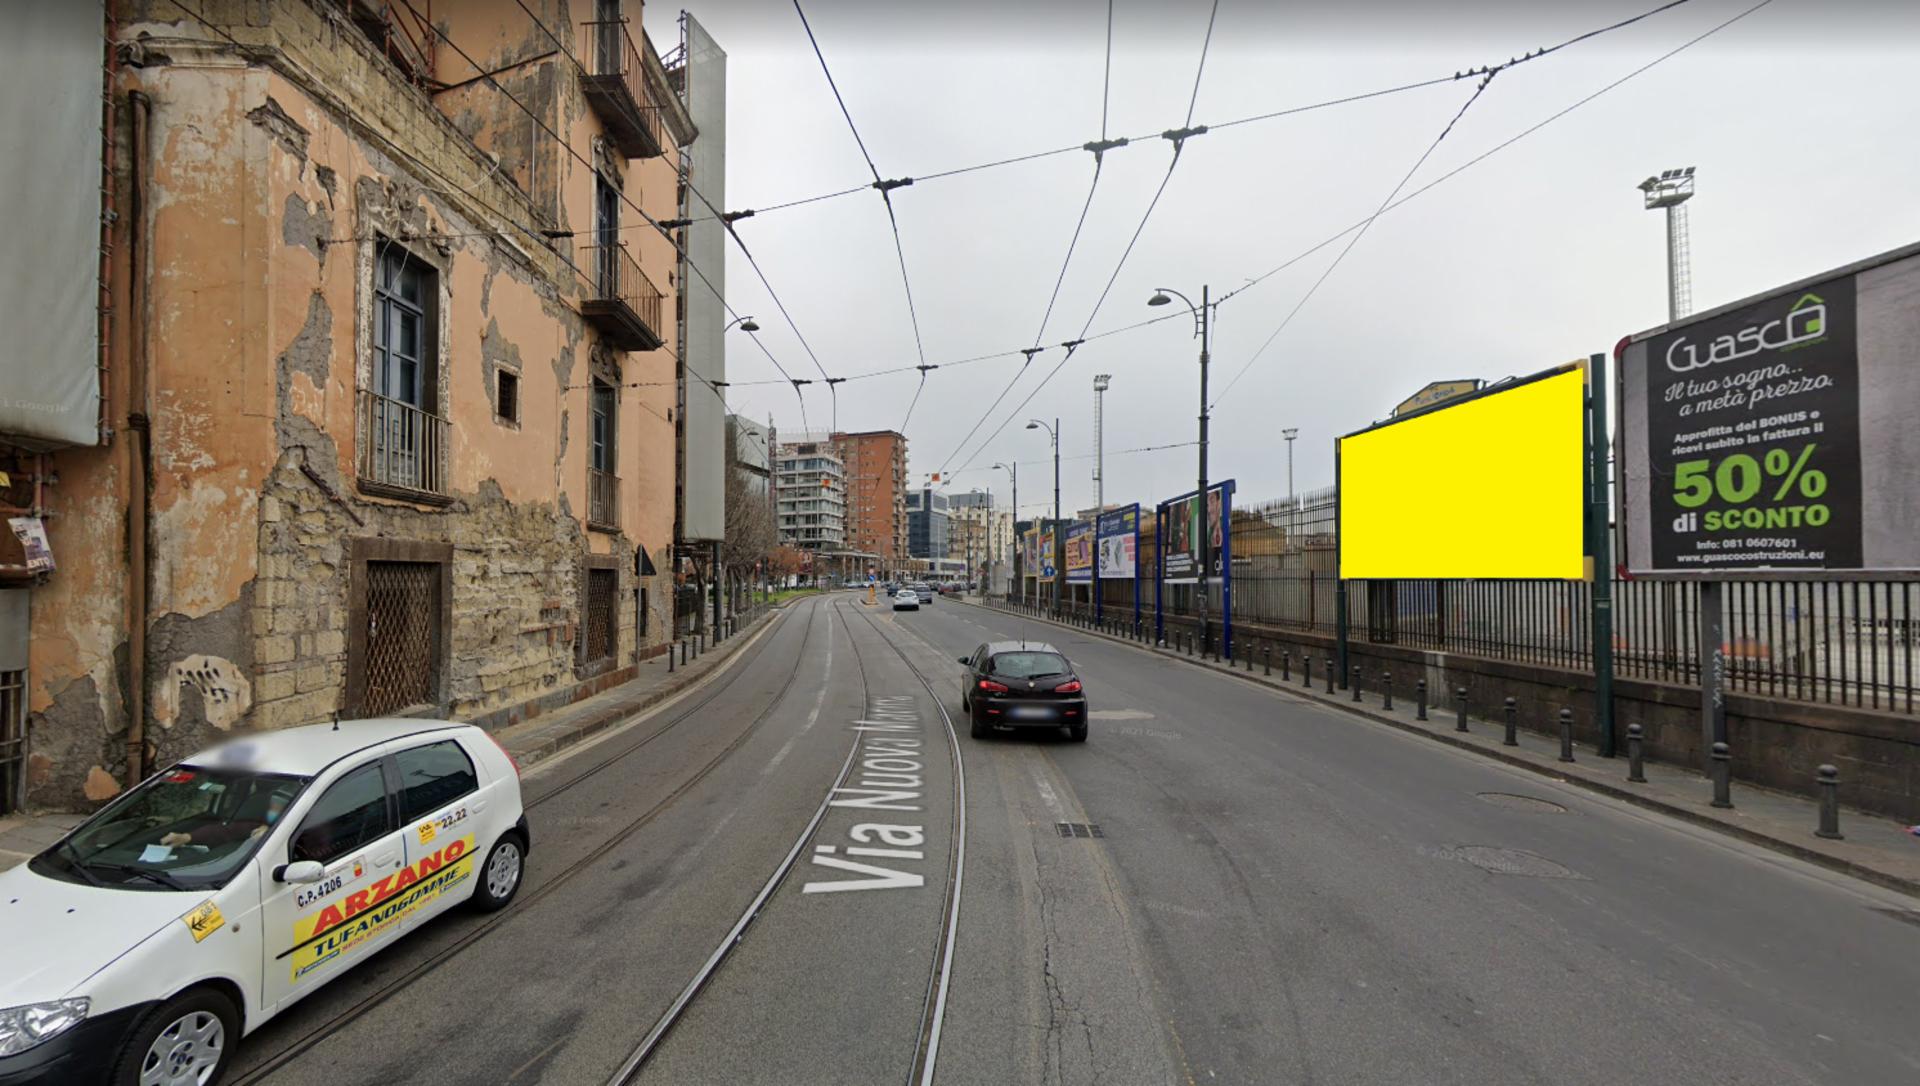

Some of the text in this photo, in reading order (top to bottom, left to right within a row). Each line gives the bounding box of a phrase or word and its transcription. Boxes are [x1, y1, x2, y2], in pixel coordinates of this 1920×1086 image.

[1664, 381, 1684, 402] Il
[1687, 379, 1719, 397] tuo
[1678, 403, 1694, 417] a
[1695, 389, 1746, 413] metà
[1672, 422, 1824, 455] ricevi subito in fattura il
[1674, 410, 1821, 443] Approfitta del BONUS e
[1672, 443, 1828, 508] 50%
[1672, 504, 1830, 533] di SCONTO
[1676, 550, 1825, 563] www.guascocostruzioni.eu
[1696, 538, 1797, 550] Info: 081 0607601
[312, 839, 465, 935] ARZANO
[314, 866, 461, 957] TUFANOGOMME
